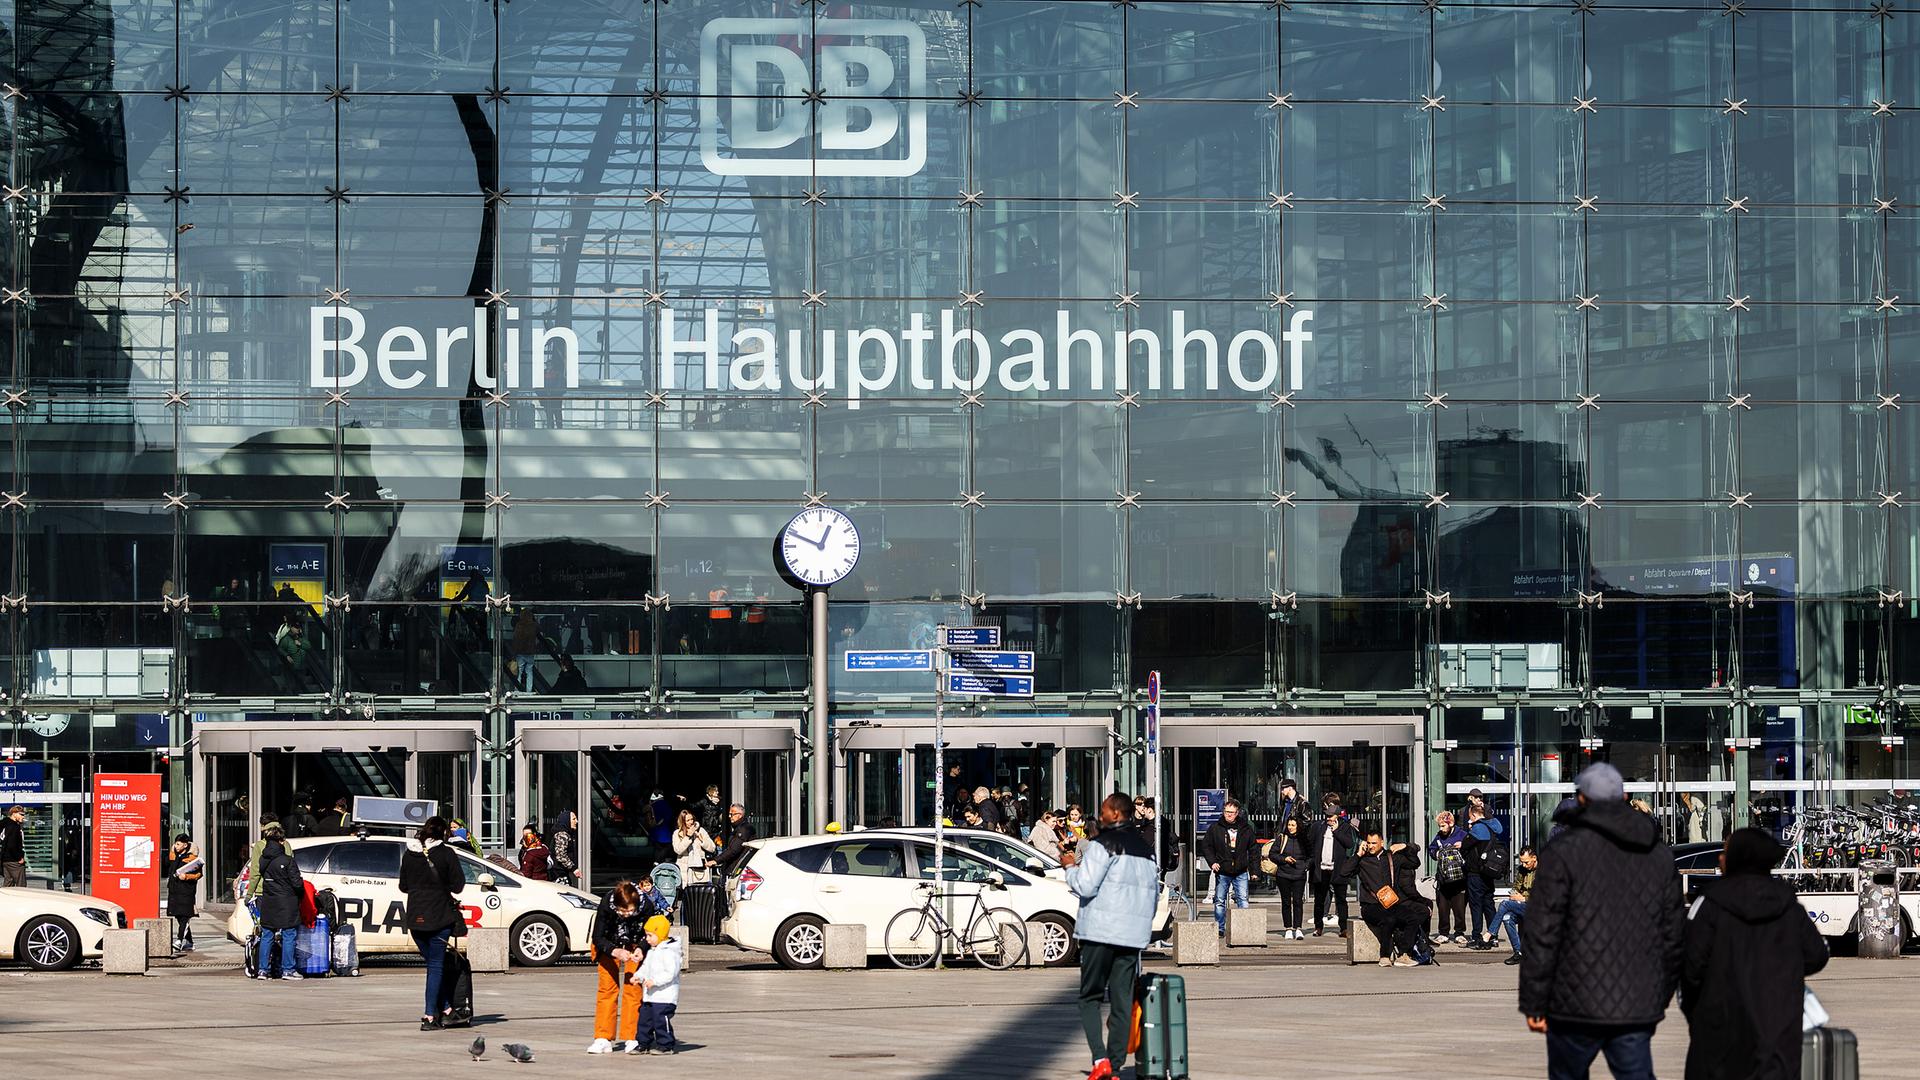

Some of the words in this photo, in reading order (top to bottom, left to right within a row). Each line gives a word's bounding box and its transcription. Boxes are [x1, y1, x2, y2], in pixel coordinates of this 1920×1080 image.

[731, 44, 898, 151] DB
[311, 307, 580, 390] Berlin
[660, 308, 1314, 409] Hauptbahnhof
[301, 561, 320, 570] A-E
[447, 562, 466, 571] E-G
[699, 560, 713, 573] 12
[1644, 568, 1666, 579] Abfahrt
[1513, 575, 1534, 585] Abfahrt
[131, 794, 148, 802] WEG
[112, 803, 126, 811] HBF
[350, 878, 387, 886] plan-b.taxi
[339, 897, 408, 934] PLA
